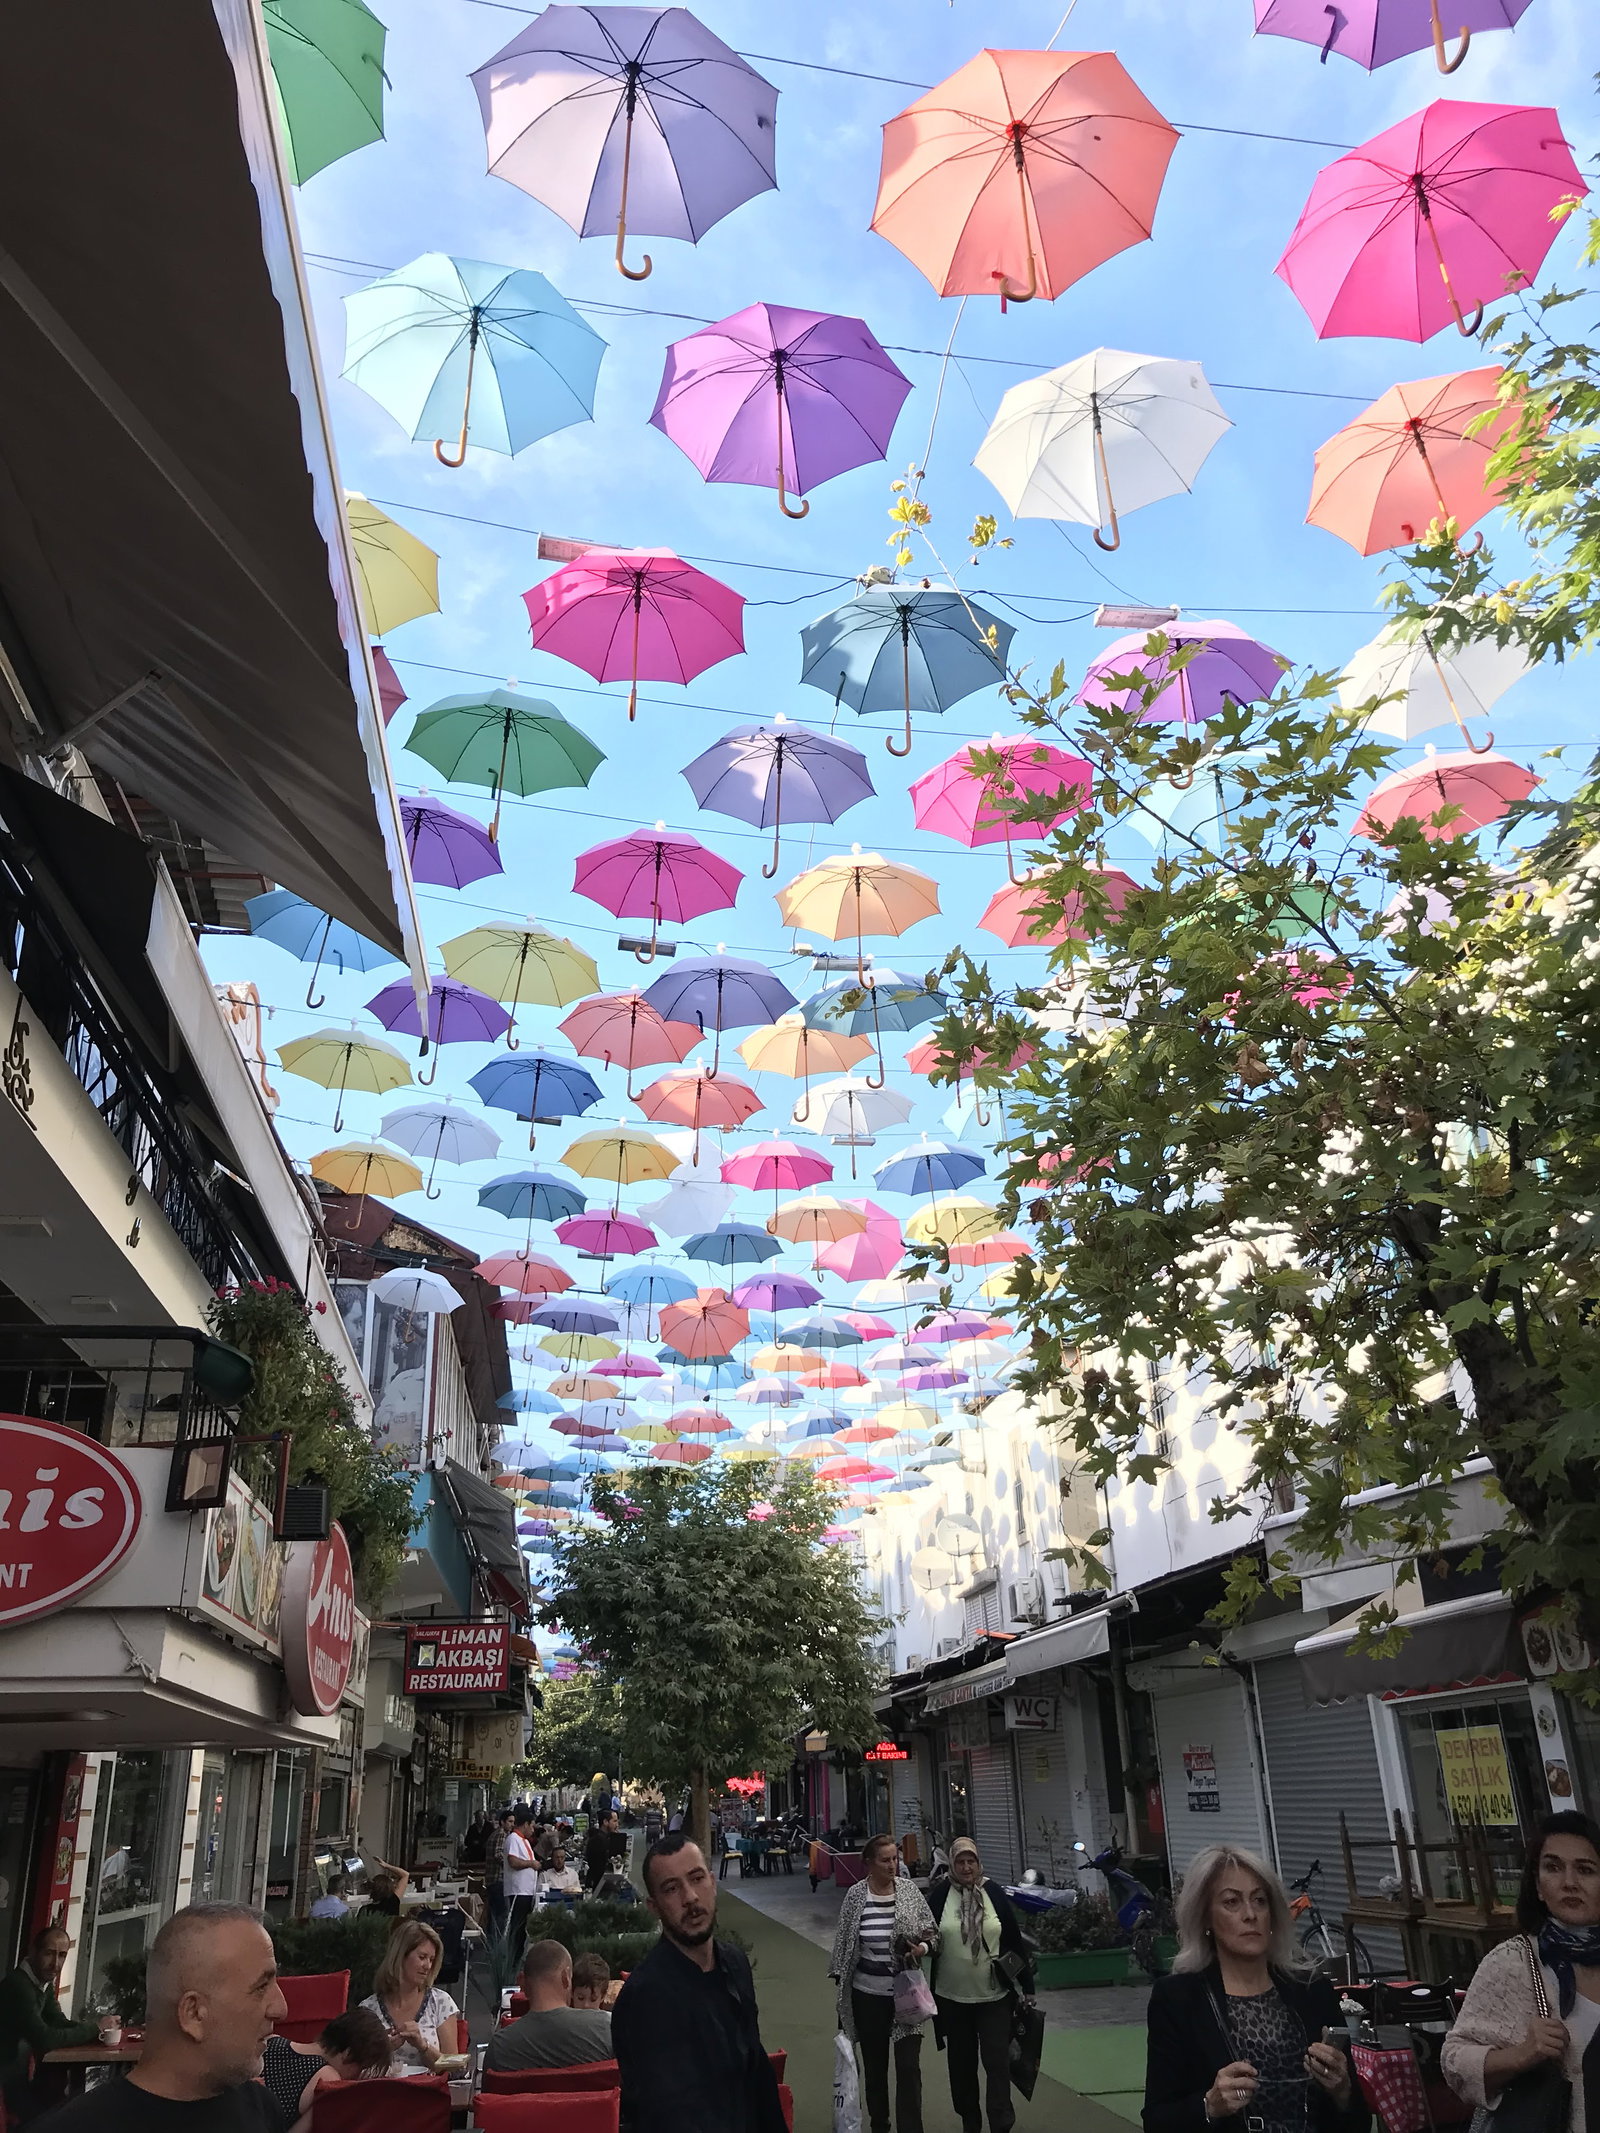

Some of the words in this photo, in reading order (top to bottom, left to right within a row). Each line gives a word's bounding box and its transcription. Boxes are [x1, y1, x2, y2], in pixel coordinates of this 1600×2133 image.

[436, 1648, 504, 1671] AKBAŞI
[409, 1672, 503, 1690] RESTAURANT
[1013, 1698, 1050, 1718] WC
[1443, 1737, 1500, 1759] DEVREN
[1451, 1766, 1505, 1788] SATILIK
